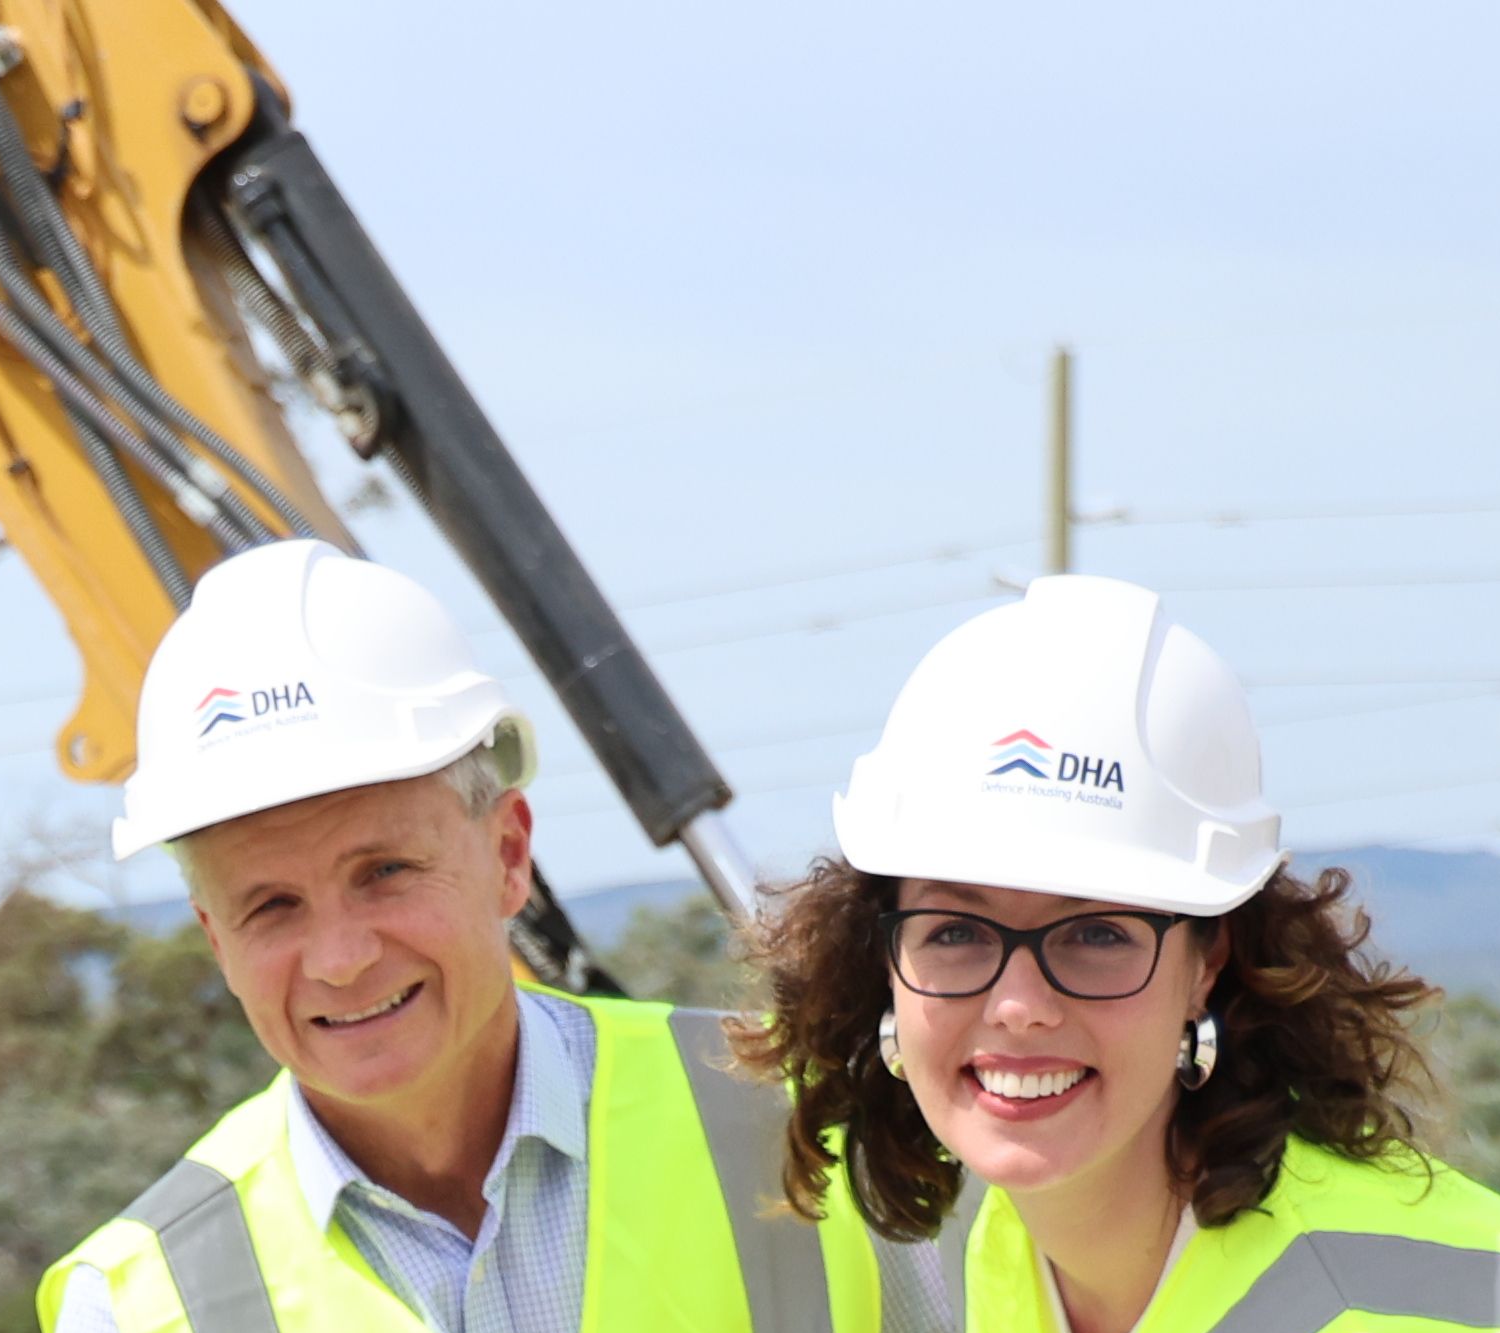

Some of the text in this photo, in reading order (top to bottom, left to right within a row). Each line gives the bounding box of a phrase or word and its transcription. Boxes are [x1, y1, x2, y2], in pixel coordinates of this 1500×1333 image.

[252, 681, 315, 716] DHA
[1058, 752, 1124, 792] DHA
[1027, 785, 1072, 802] Housing
[1075, 791, 1123, 810] Australia
